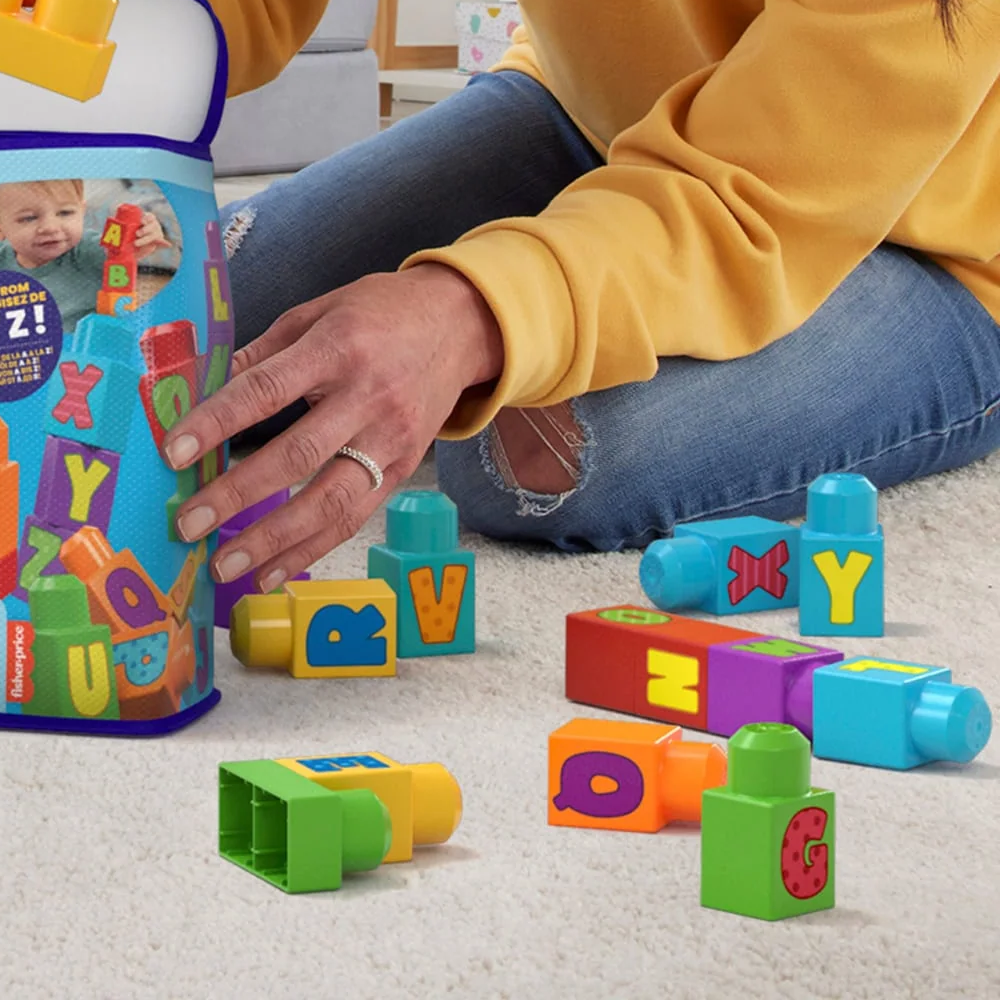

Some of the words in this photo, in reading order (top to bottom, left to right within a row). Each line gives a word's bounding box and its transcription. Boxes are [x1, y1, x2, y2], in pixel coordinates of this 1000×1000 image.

[103, 222, 122, 247] A
[29, 291, 47, 303] DE
[108, 264, 130, 288] B
[51, 361, 104, 429] X
[63, 453, 111, 523] Y
[19, 525, 63, 591] Z
[726, 539, 790, 606] X
[811, 549, 874, 625] Y
[105, 566, 168, 629] Q
[408, 564, 469, 645] V
[11, 624, 27, 699] fisher-price
[306, 603, 388, 667] R
[67, 641, 111, 717] U
[553, 751, 645, 818] Q
[780, 806, 829, 900] G
